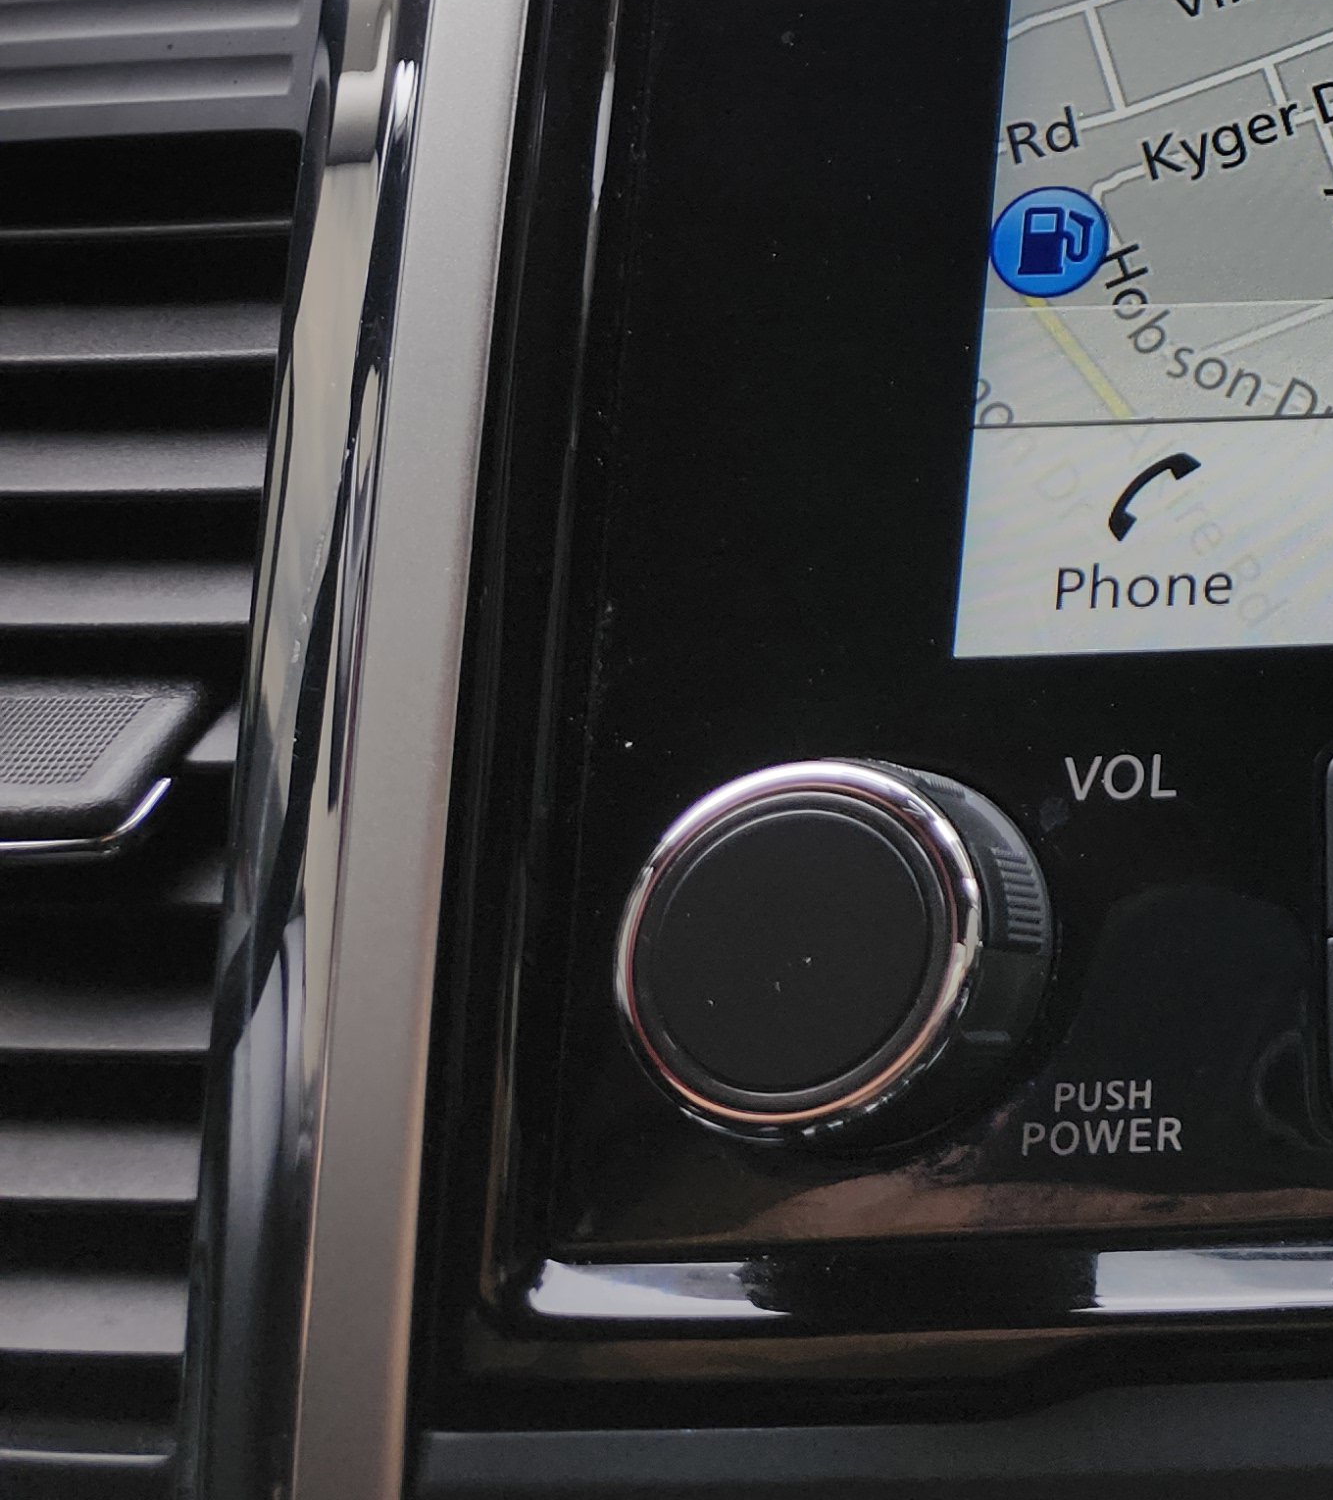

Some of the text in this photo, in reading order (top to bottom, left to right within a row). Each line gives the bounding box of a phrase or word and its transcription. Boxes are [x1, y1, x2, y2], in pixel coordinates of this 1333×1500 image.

[1006, 107, 1080, 164] Rd
[1142, 102, 1298, 180] Kyger
[1103, 244, 1262, 406] Hobson
[1055, 564, 1233, 610] Phone
[1065, 753, 1177, 802] VOL
[1054, 1079, 1153, 1114] PUSH
[1021, 1118, 1183, 1158] POWER
